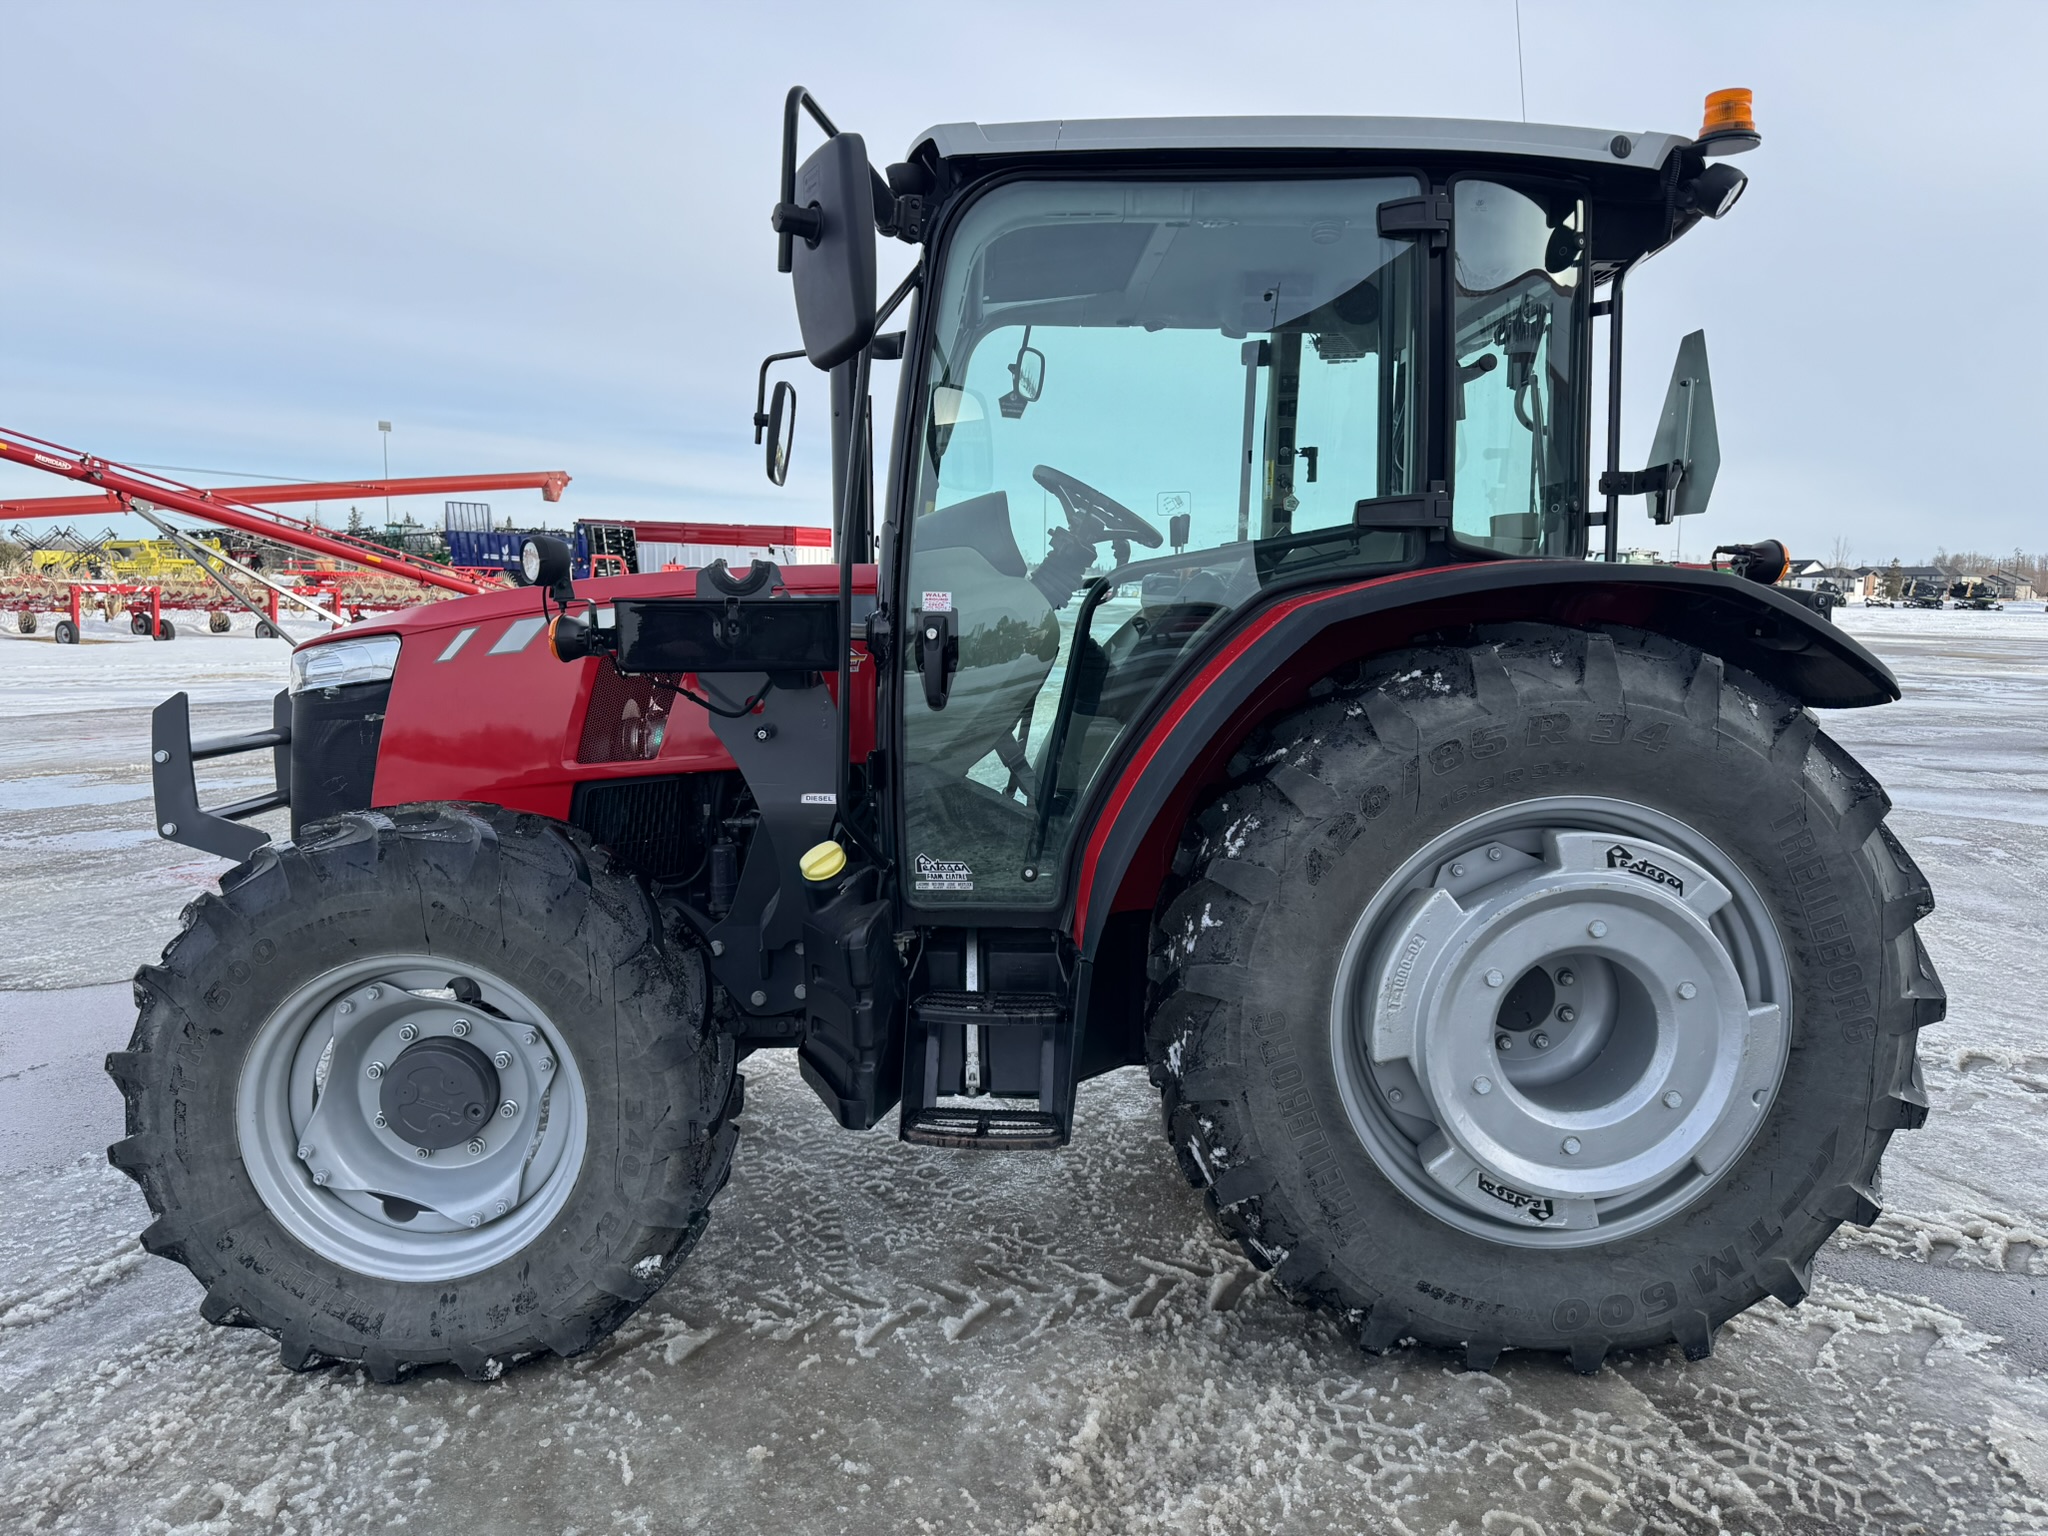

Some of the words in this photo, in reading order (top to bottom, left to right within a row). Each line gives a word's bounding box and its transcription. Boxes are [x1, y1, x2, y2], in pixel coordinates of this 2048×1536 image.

[34, 453, 71, 469] MERIDIAN
[915, 854, 972, 874] Pentagon
[1606, 844, 1684, 897] Pentagon
[1769, 800, 1878, 1044] TRELLEBORG
[1477, 1172, 1555, 1222] Pentagon
[1689, 1216, 1784, 1299] TM
